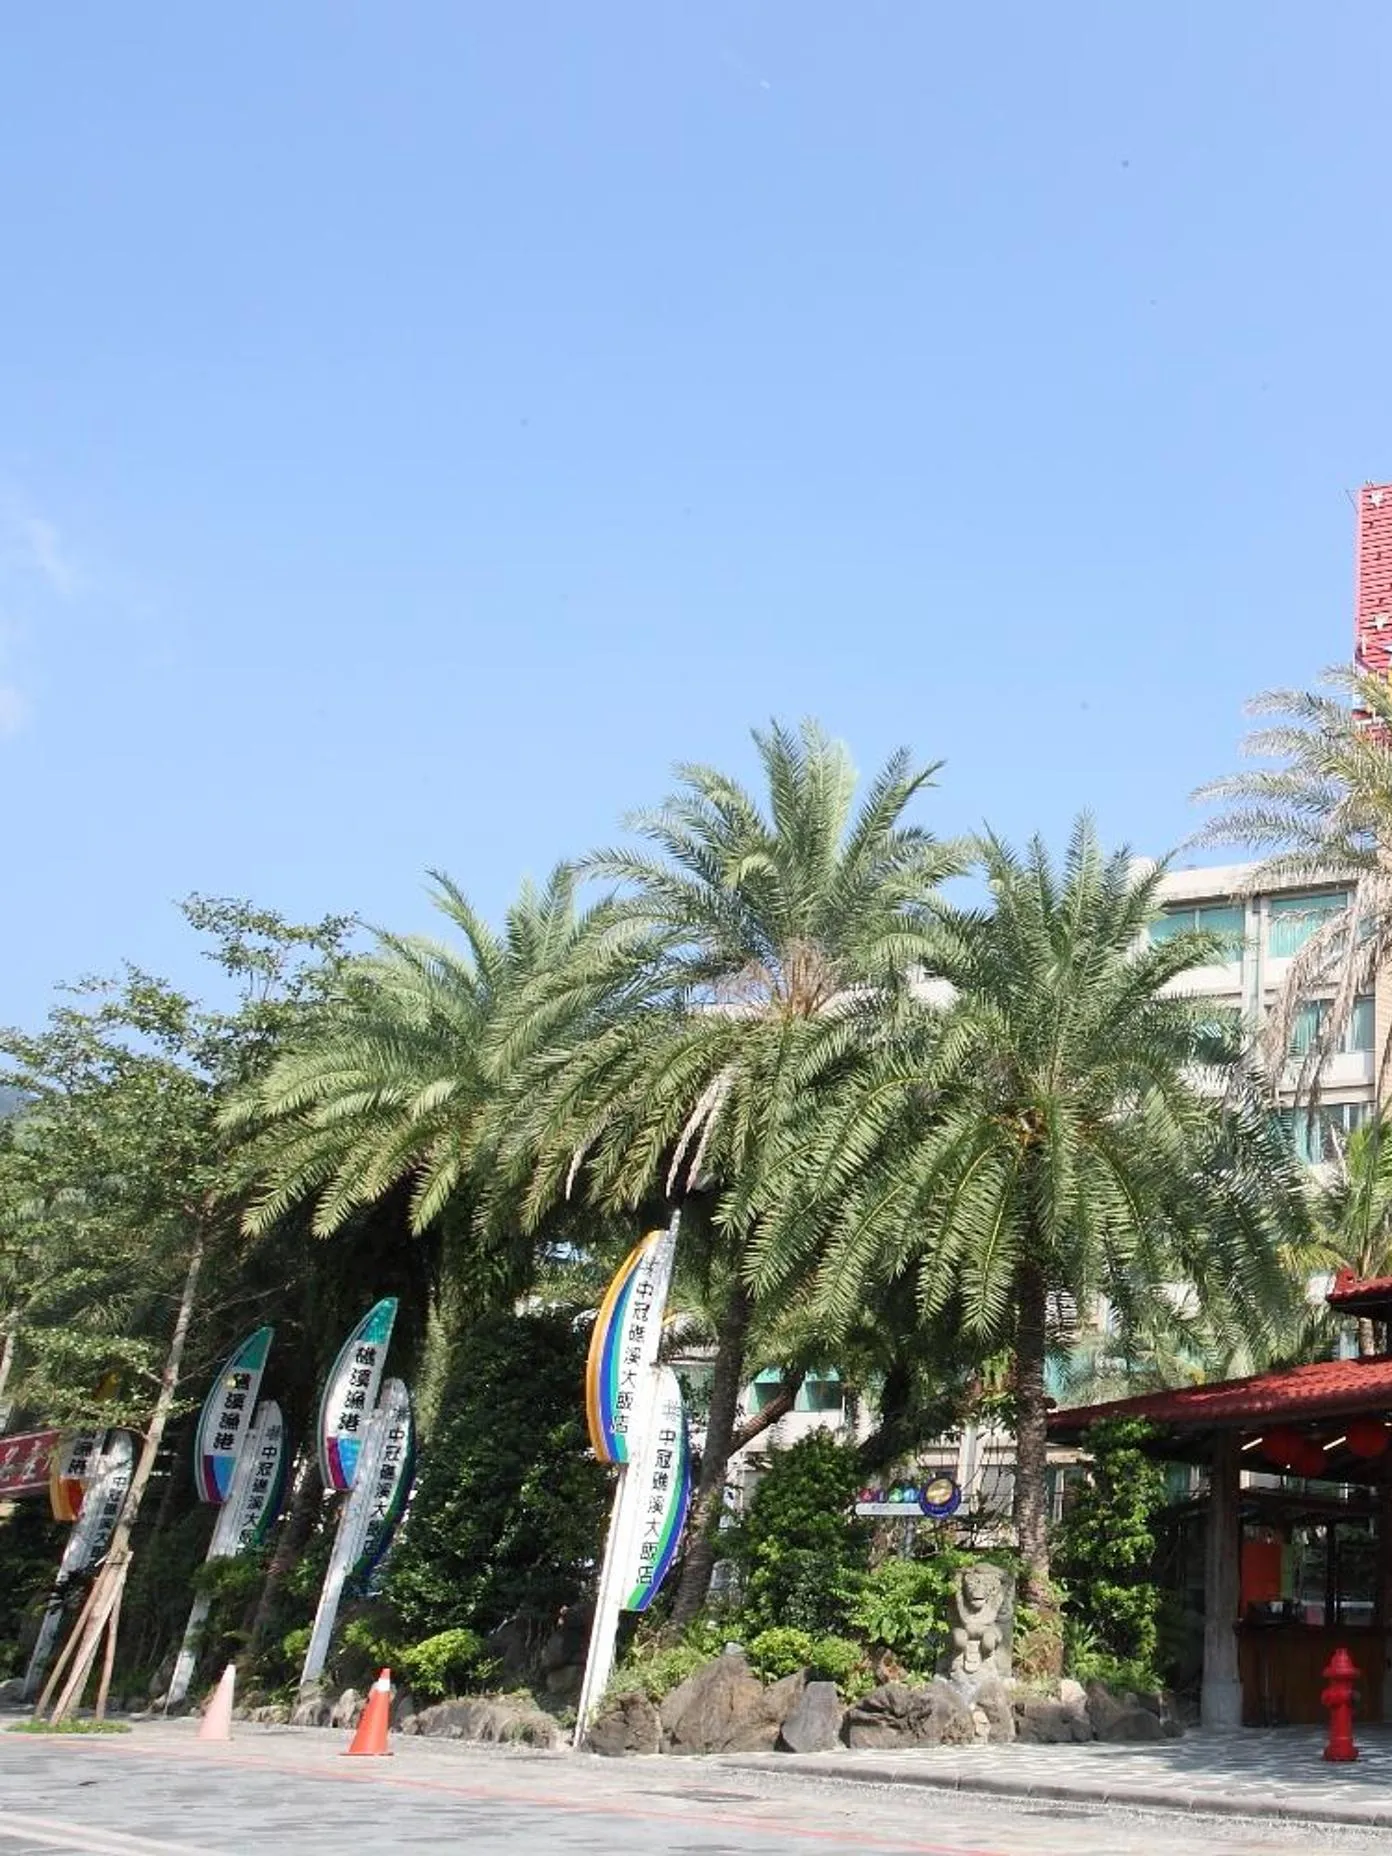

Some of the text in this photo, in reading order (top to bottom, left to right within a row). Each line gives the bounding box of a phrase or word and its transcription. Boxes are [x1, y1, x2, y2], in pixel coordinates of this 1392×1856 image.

[611, 1280, 654, 1435] 中冠礁溪大飯店
[637, 1429, 677, 1585] 中冠礁溪大飯店
